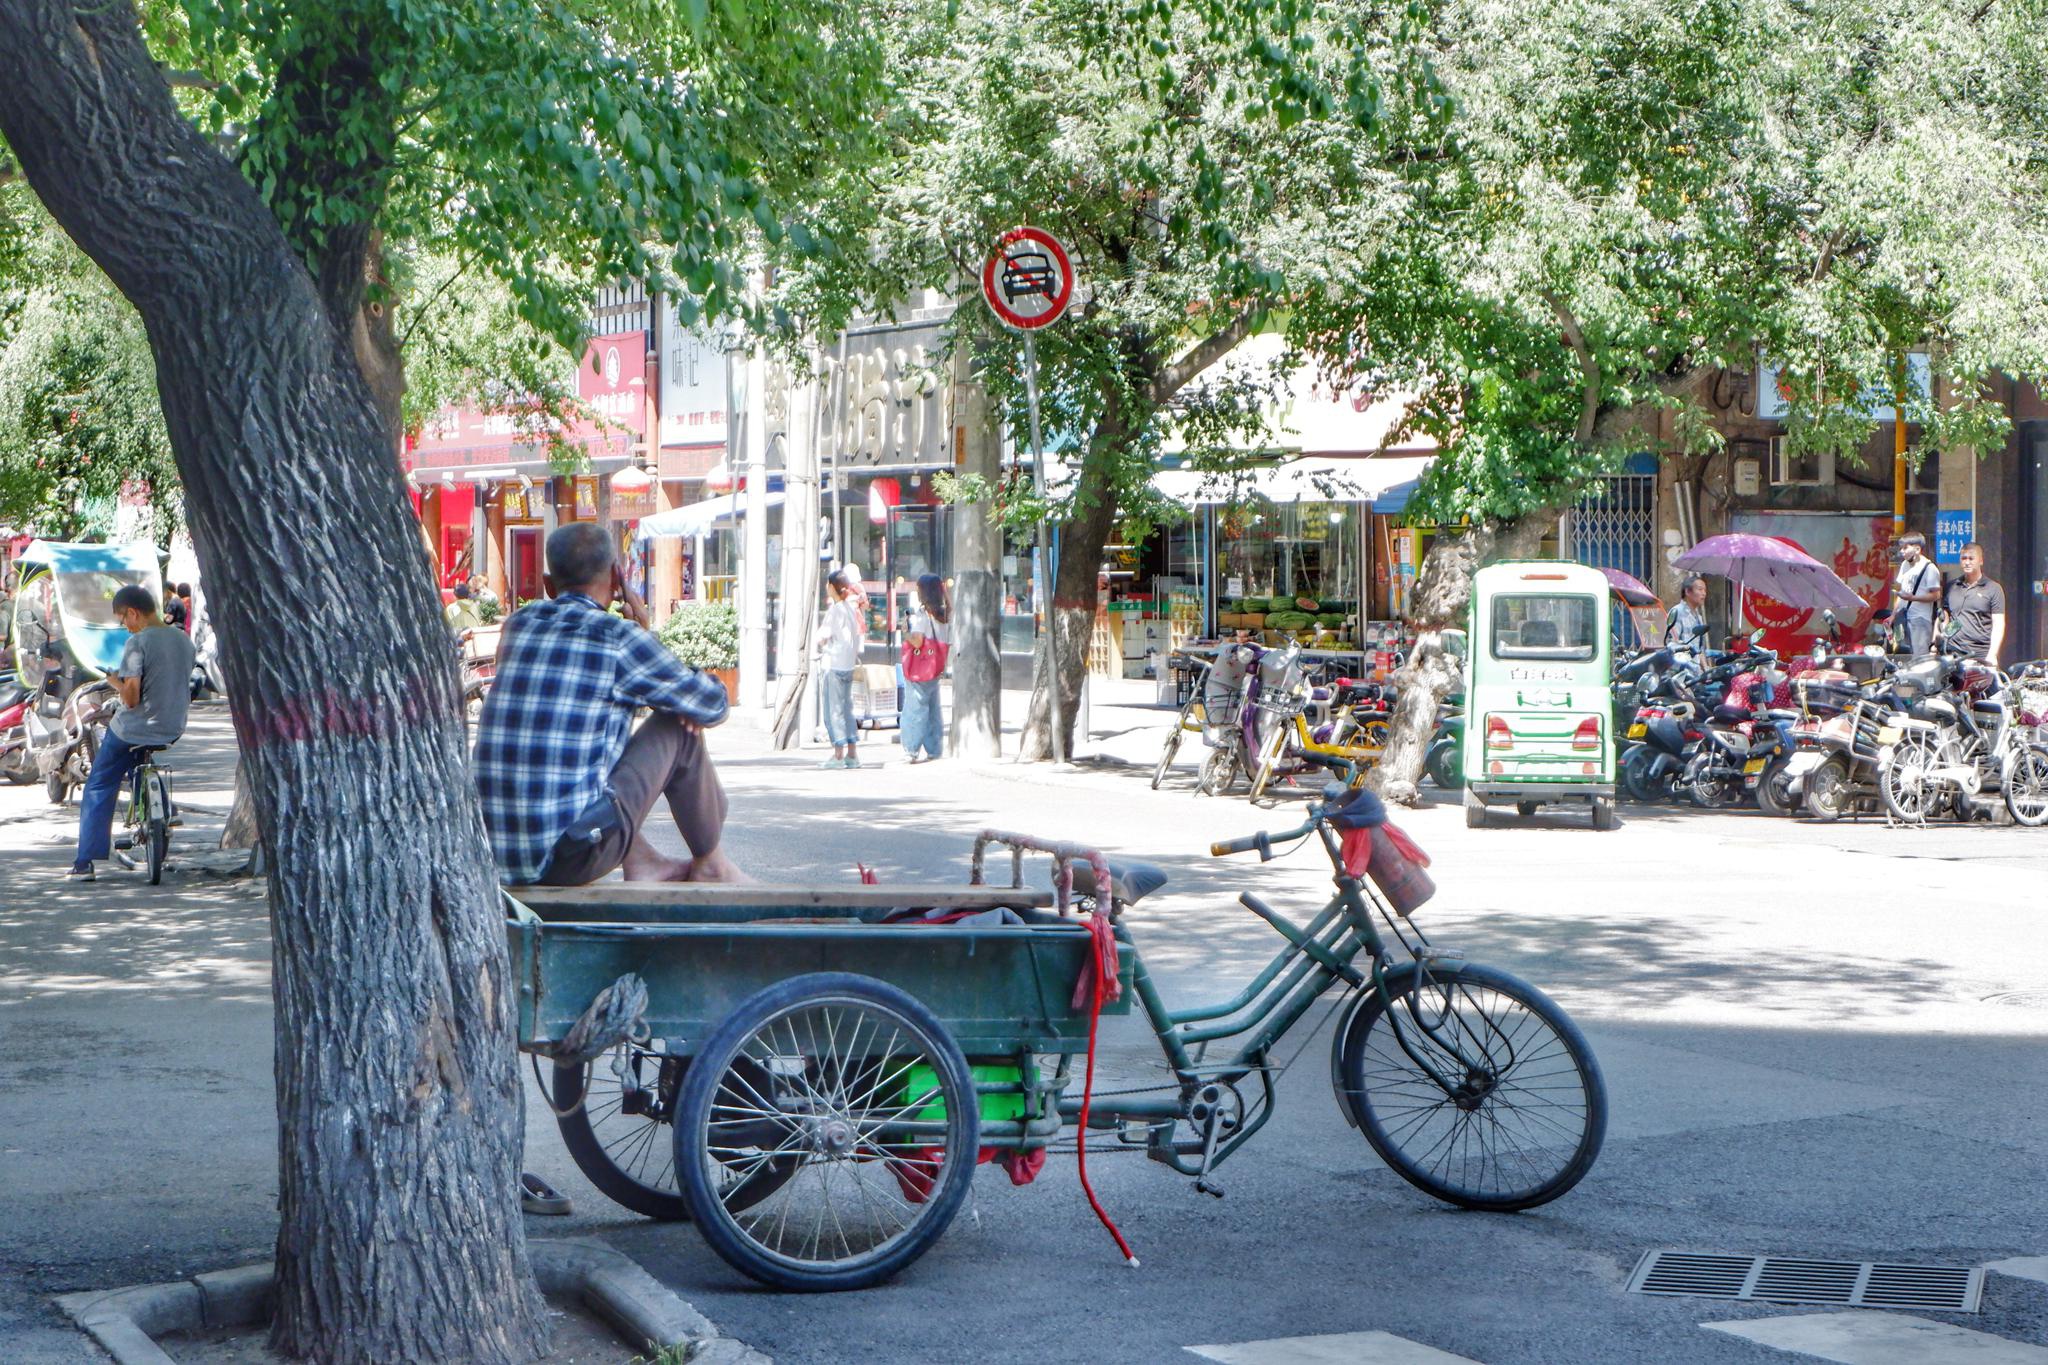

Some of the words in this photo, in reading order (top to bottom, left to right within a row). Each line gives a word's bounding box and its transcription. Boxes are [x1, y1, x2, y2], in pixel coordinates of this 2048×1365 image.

[1936, 520, 1972, 535] 非本小区车
